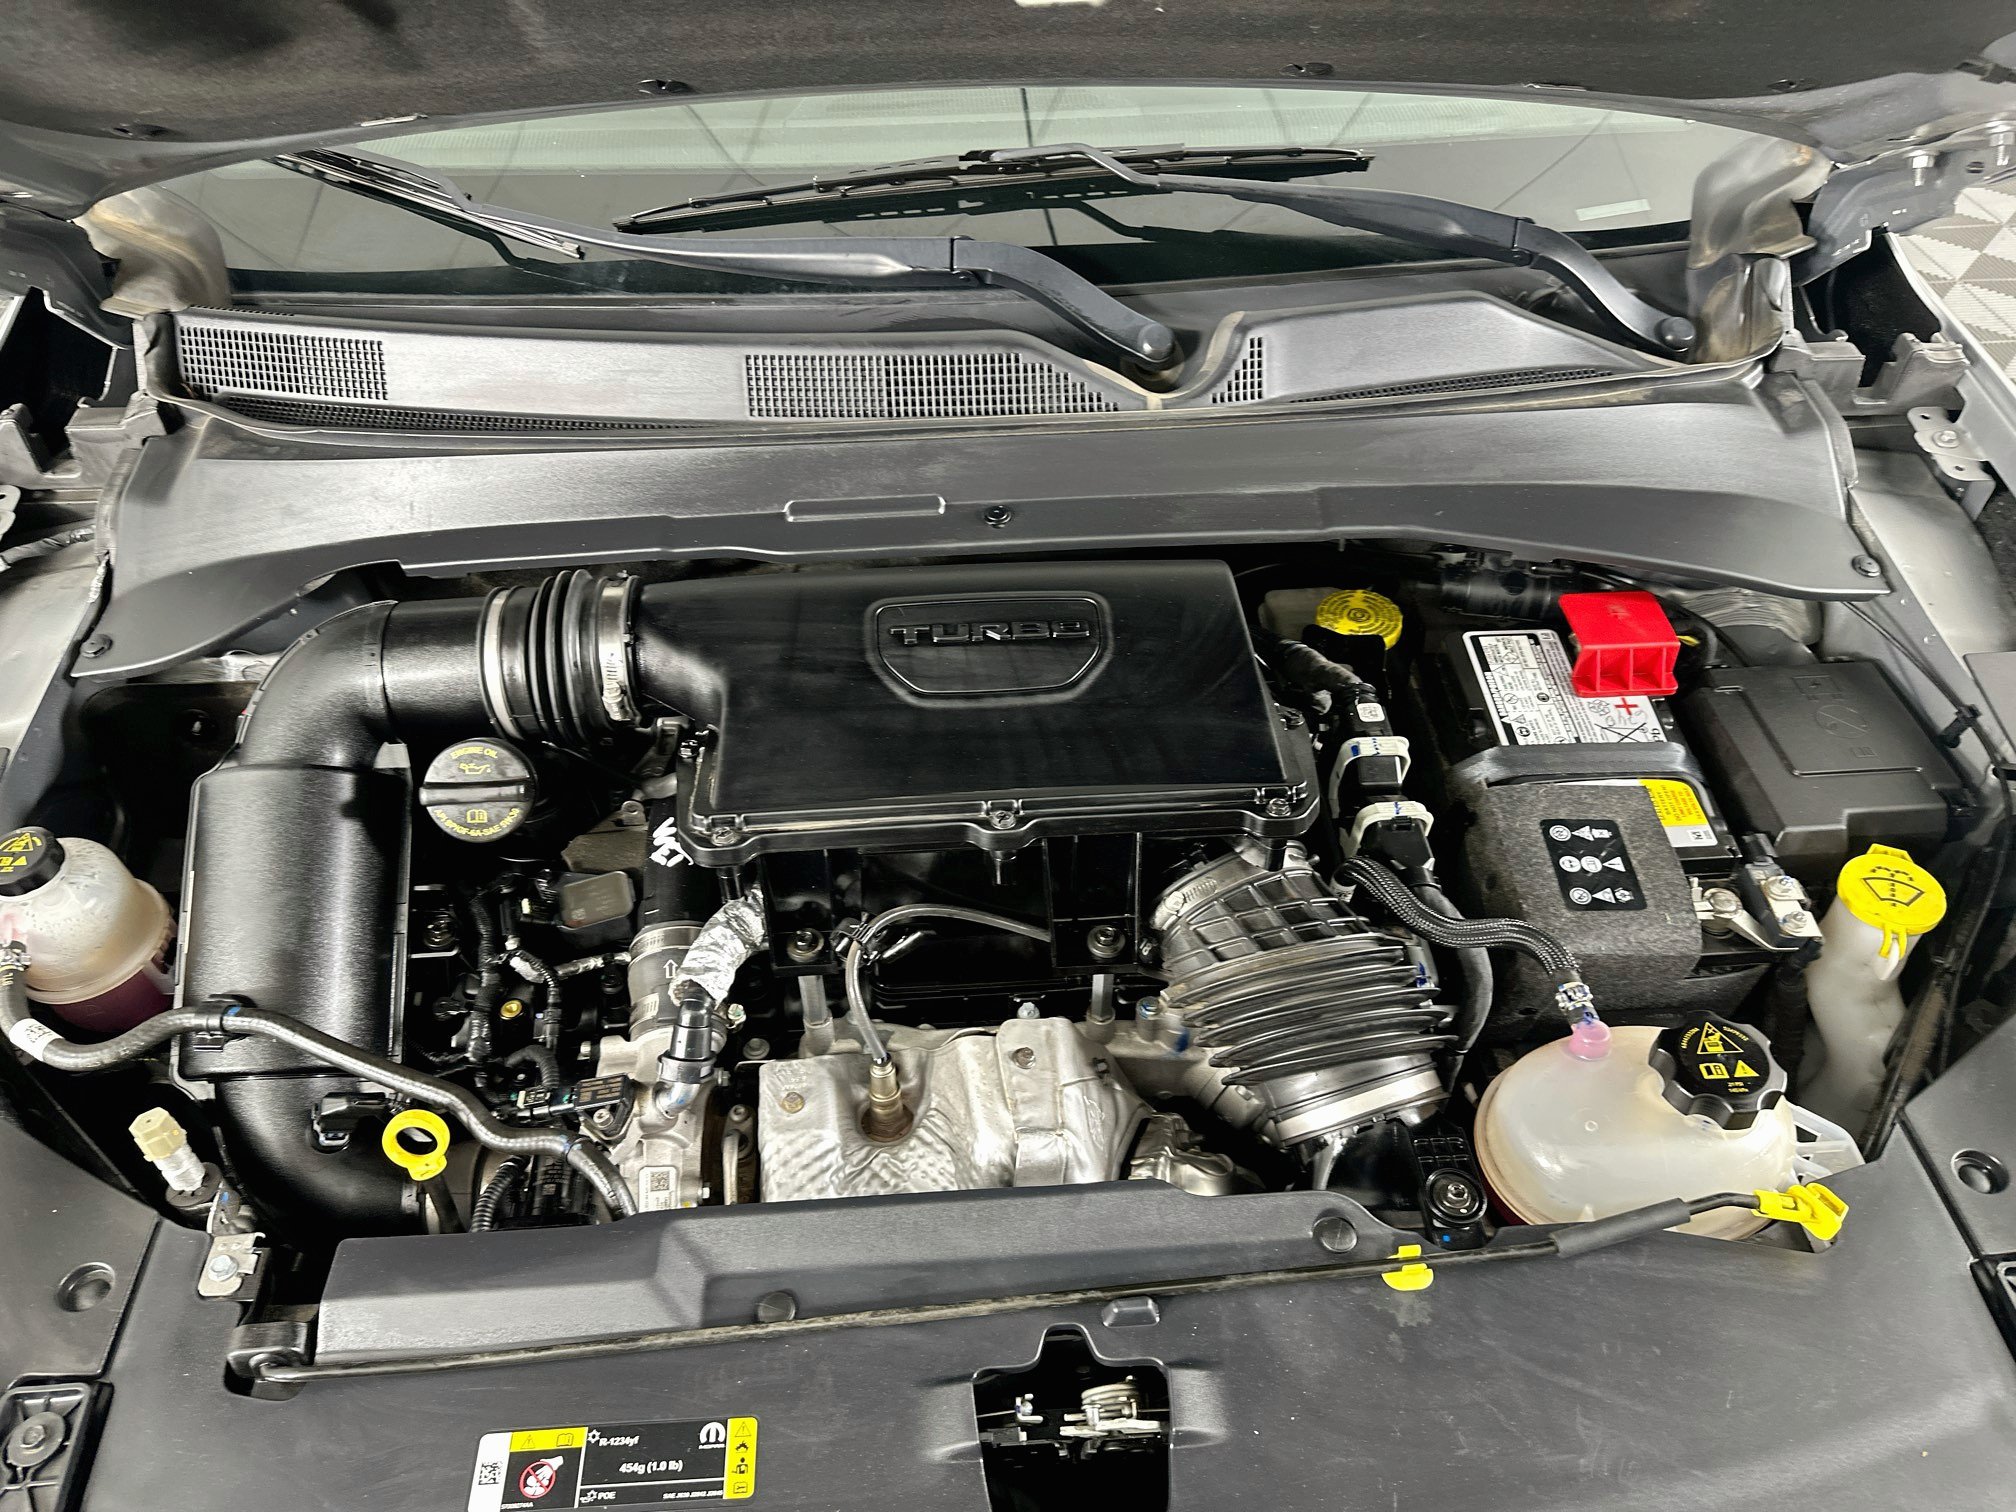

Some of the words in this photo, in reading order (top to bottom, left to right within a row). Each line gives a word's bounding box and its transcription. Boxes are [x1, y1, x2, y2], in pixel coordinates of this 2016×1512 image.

[890, 620, 1090, 644] TURBO
[450, 746, 484, 759] ENGINE
[484, 748, 498, 759] OIL
[434, 808, 448, 822] API
[599, 1436, 640, 1447] R-1234yf
[618, 1462, 646, 1474] 454g
[646, 1460, 667, 1474] (1.0
[668, 1459, 684, 1472] lb)
[597, 1491, 616, 1500] POE
